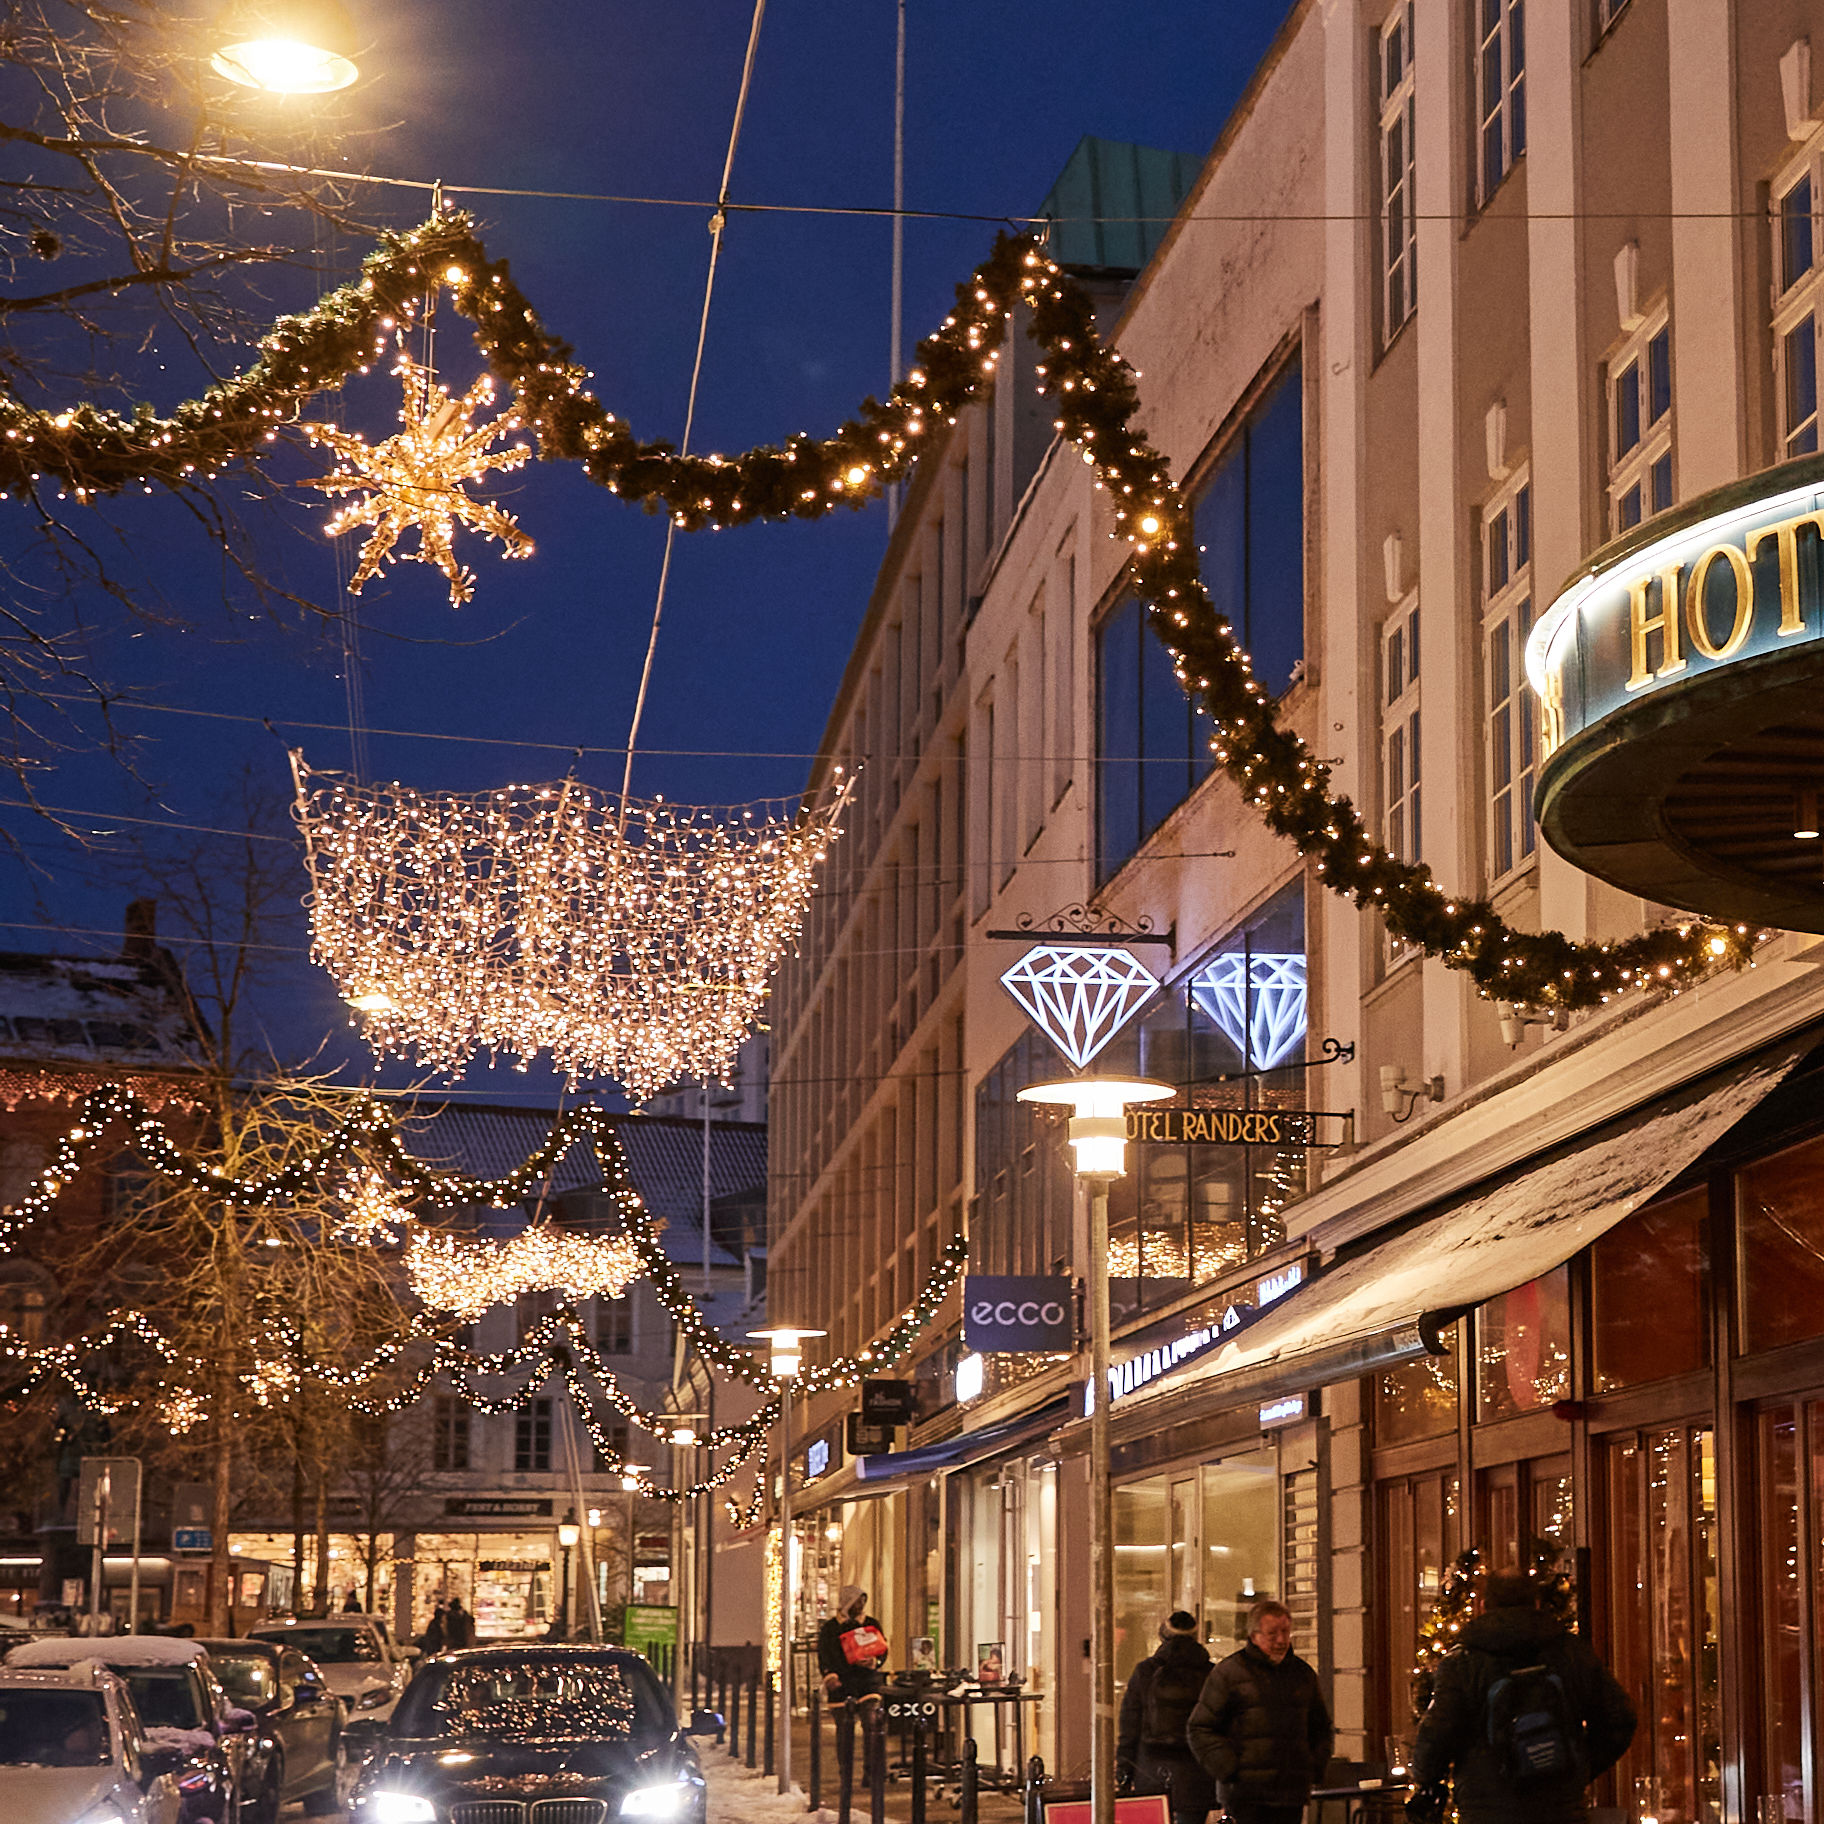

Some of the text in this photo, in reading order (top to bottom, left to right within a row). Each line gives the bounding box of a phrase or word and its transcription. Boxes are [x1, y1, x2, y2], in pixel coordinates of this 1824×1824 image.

[1126, 1111, 1280, 1143] OTEL RANDERS
[971, 1301, 1065, 1326] ecco
